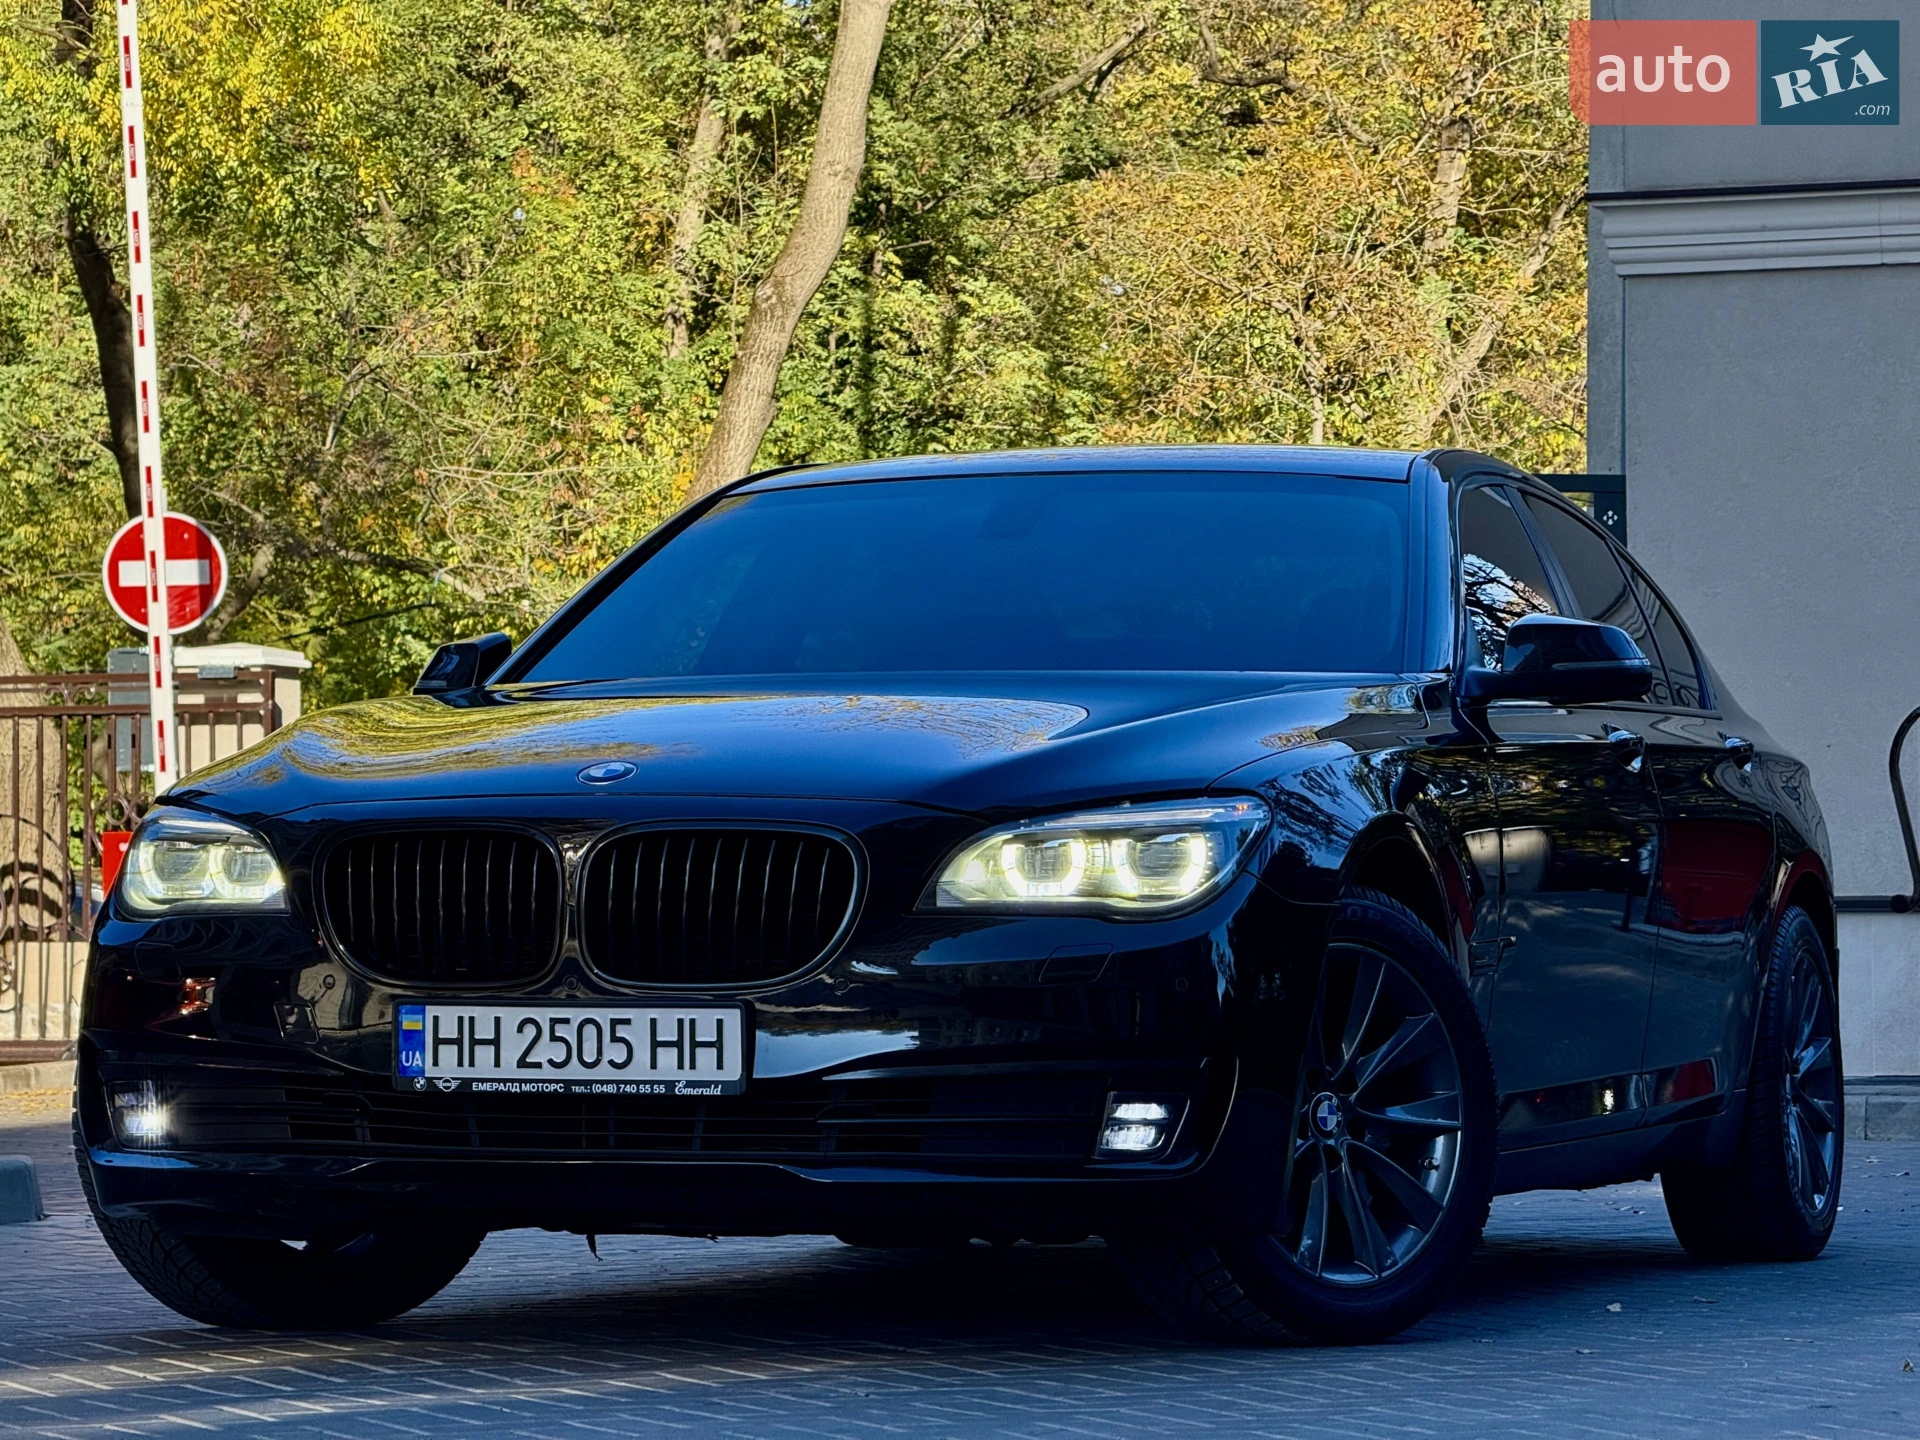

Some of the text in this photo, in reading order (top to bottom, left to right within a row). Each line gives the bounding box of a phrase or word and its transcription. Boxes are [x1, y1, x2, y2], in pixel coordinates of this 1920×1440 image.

[431, 1014, 724, 1071] HH 2505 HH
[402, 1053, 423, 1068] UA
[472, 1082, 520, 1094] ЕМЕРАЛД
[521, 1082, 565, 1093] МОТОРС
[592, 1083, 617, 1094] (048)
[619, 1083, 637, 1093] 740
[638, 1083, 651, 1093] 55
[652, 1083, 666, 1094] 55
[674, 1080, 722, 1096] Emerald
